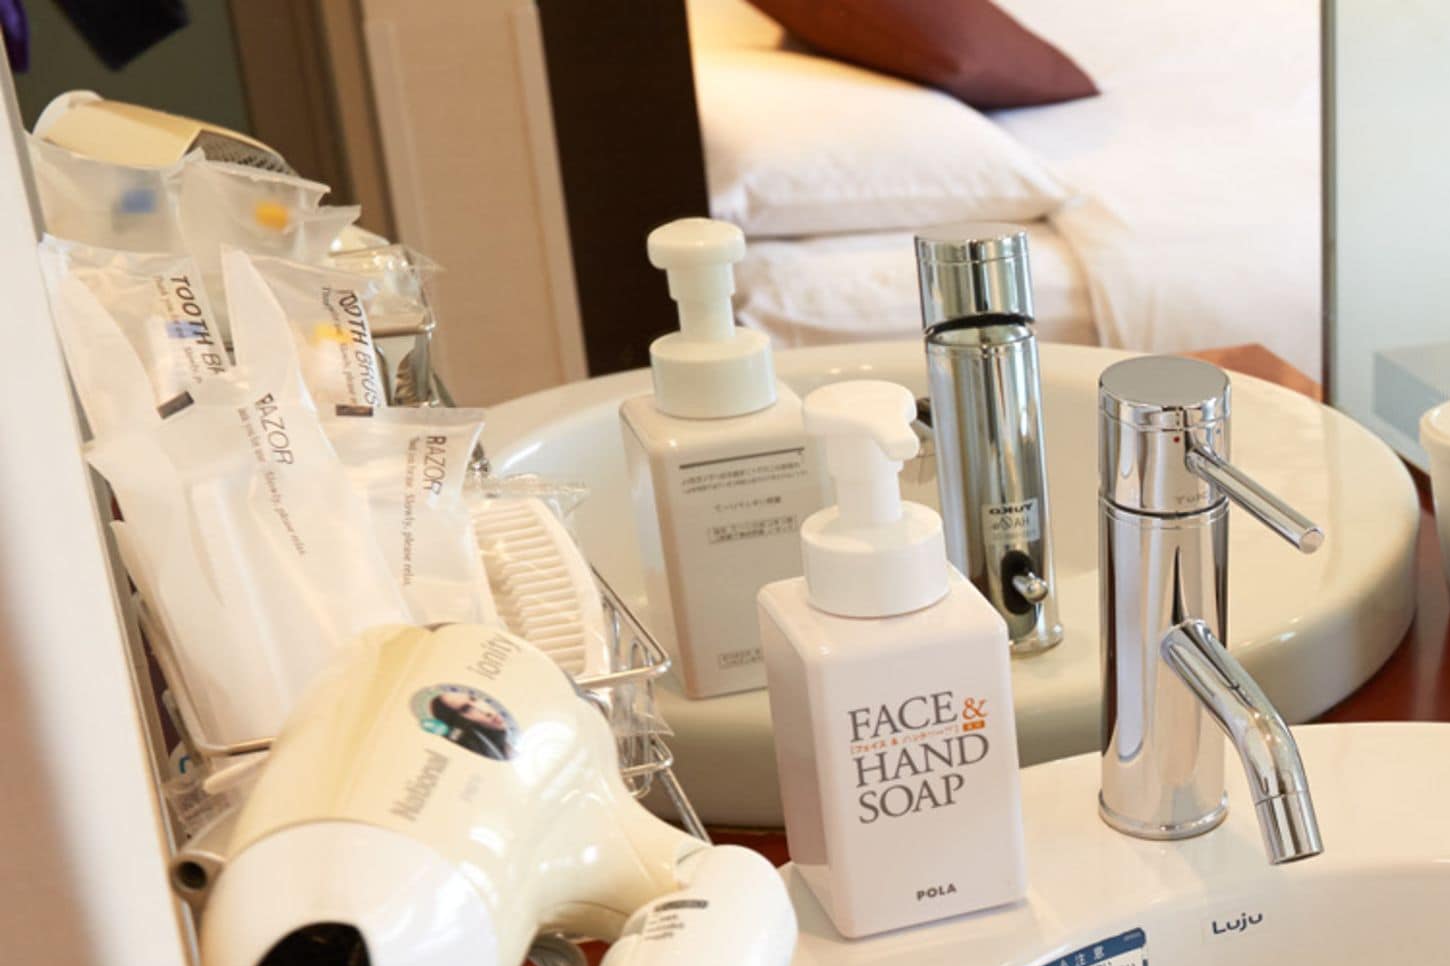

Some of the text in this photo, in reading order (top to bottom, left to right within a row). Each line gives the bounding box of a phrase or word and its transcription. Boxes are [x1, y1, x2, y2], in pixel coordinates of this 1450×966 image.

[170, 275, 214, 345] TOOTH
[255, 393, 295, 465] RAZOR
[422, 435, 447, 495] RAZOR
[848, 691, 988, 743] FACE &
[853, 733, 990, 788] HAND
[858, 773, 966, 824] SOAP
[916, 883, 957, 901] POLA
[1212, 912, 1263, 935] Luju
